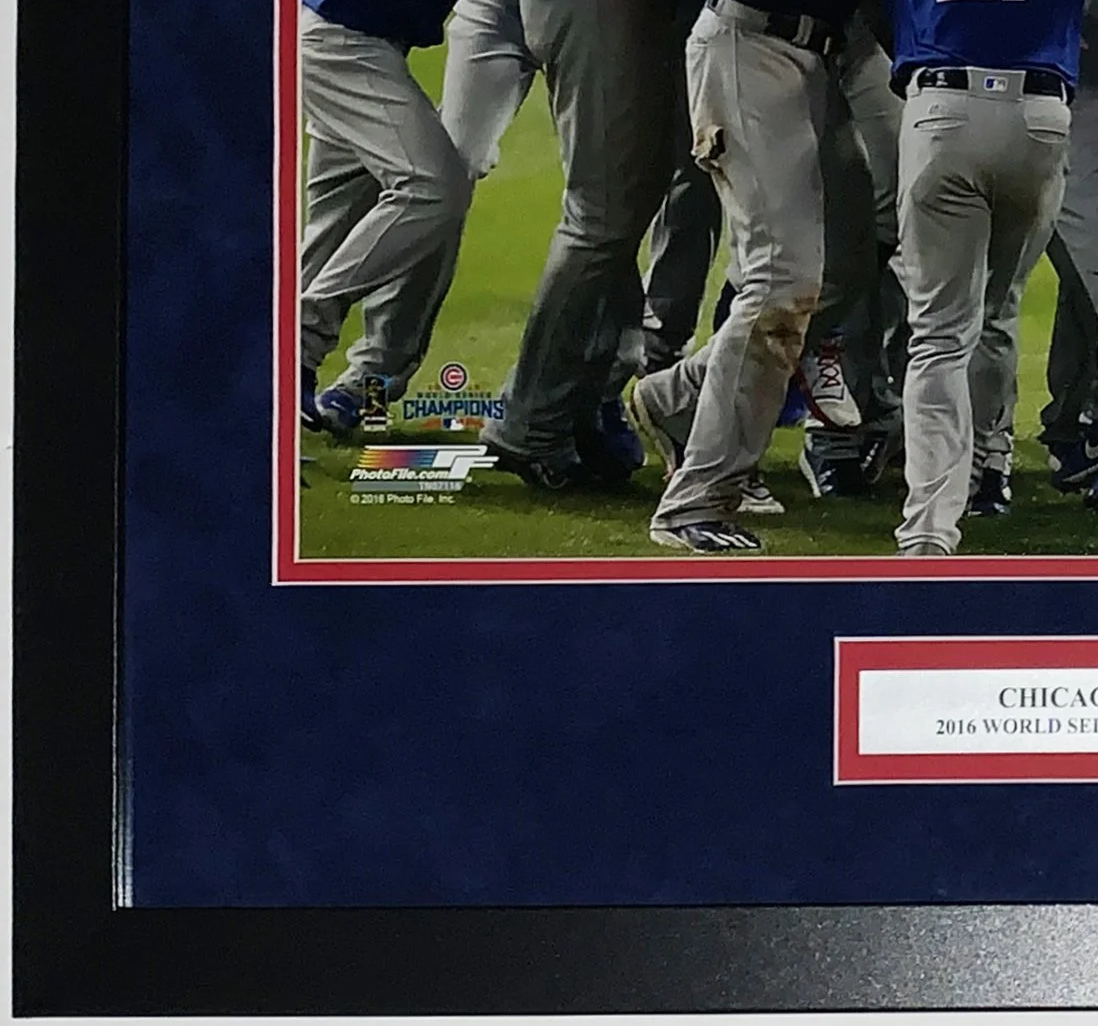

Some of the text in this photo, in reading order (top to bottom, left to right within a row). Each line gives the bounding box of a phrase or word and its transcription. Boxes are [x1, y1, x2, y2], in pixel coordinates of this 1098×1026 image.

[403, 399, 505, 420] CHAMPIONS
[350, 468, 450, 480] PhotoFile.com
[387, 494, 414, 504] Photo
[935, 718, 977, 735] 2016
[983, 718, 1062, 734] WORLD
